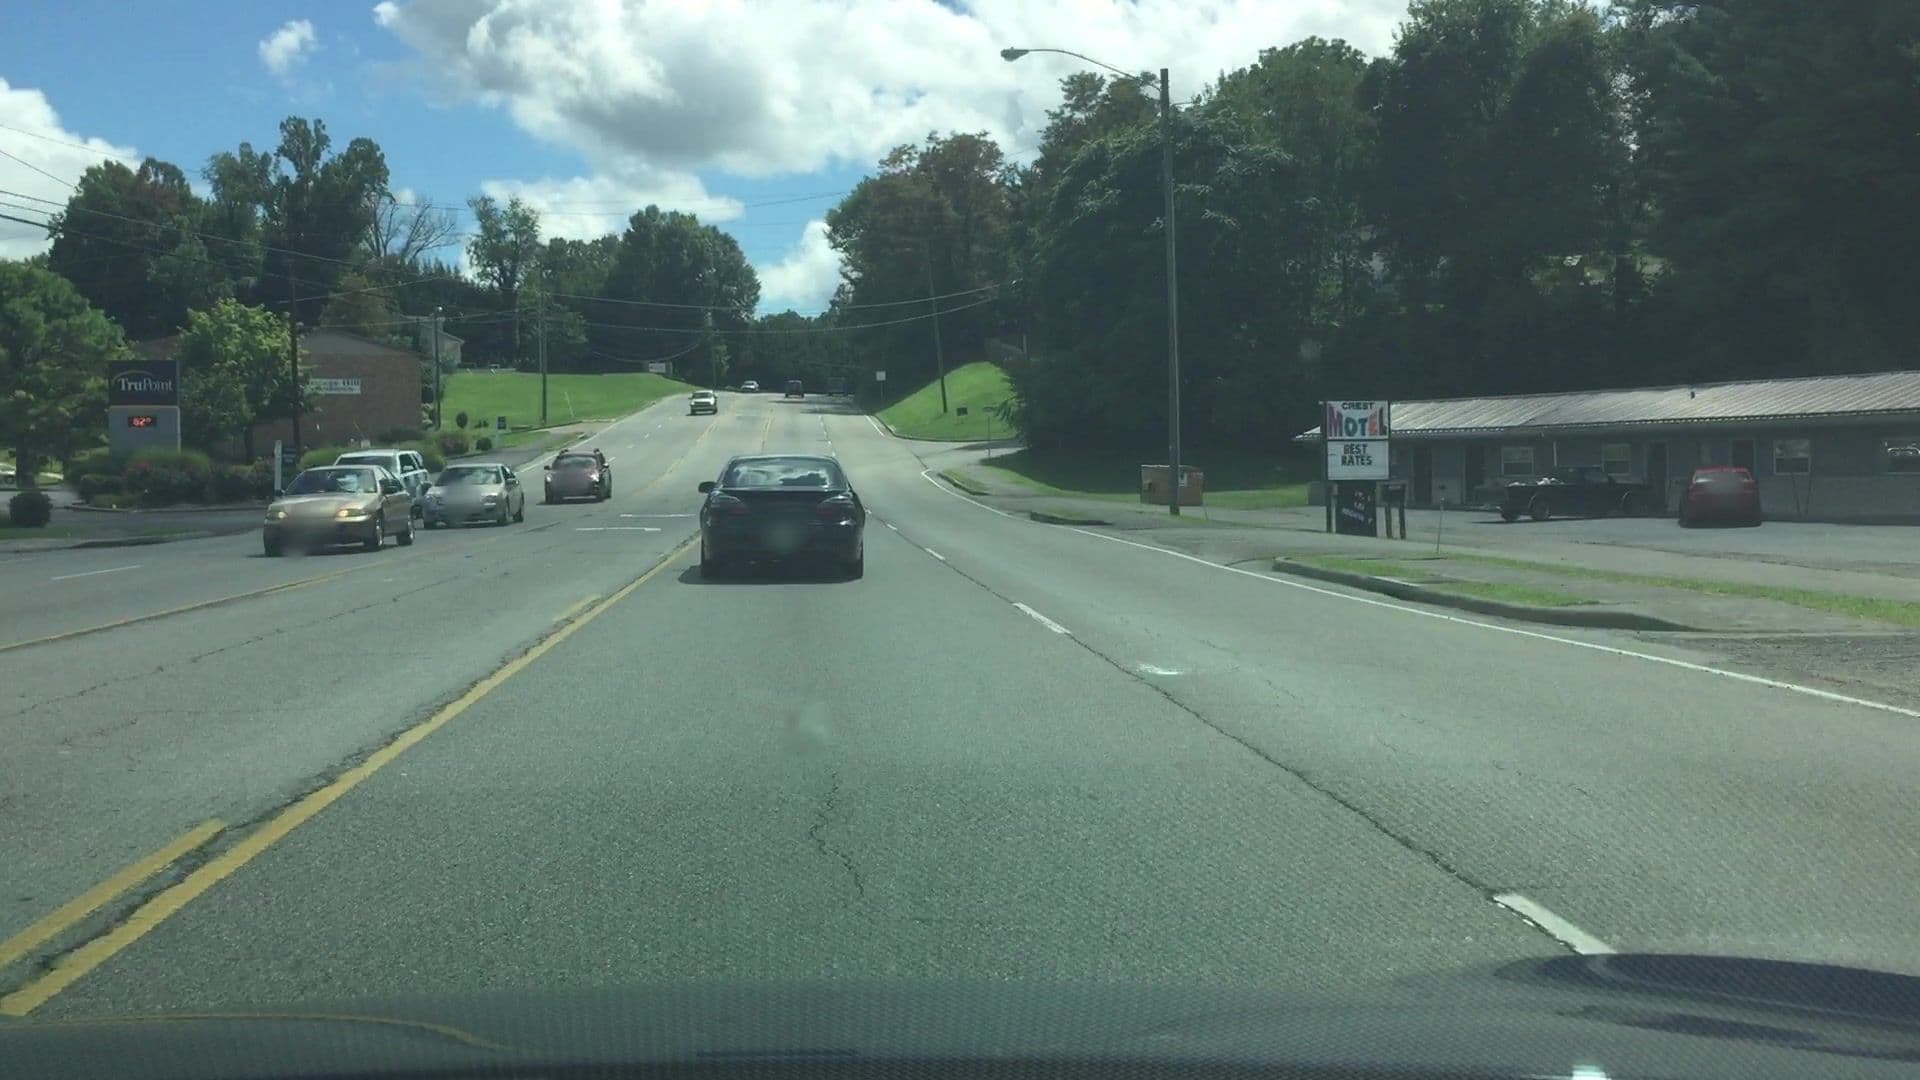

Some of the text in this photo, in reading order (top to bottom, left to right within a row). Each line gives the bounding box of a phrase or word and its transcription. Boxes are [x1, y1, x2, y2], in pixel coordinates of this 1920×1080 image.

[118, 377, 172, 391] TruPoint
[1341, 402, 1375, 410] CREST
[1328, 404, 1387, 437] MOTEL
[1344, 444, 1368, 454] BEST
[1341, 455, 1373, 466] RATES
